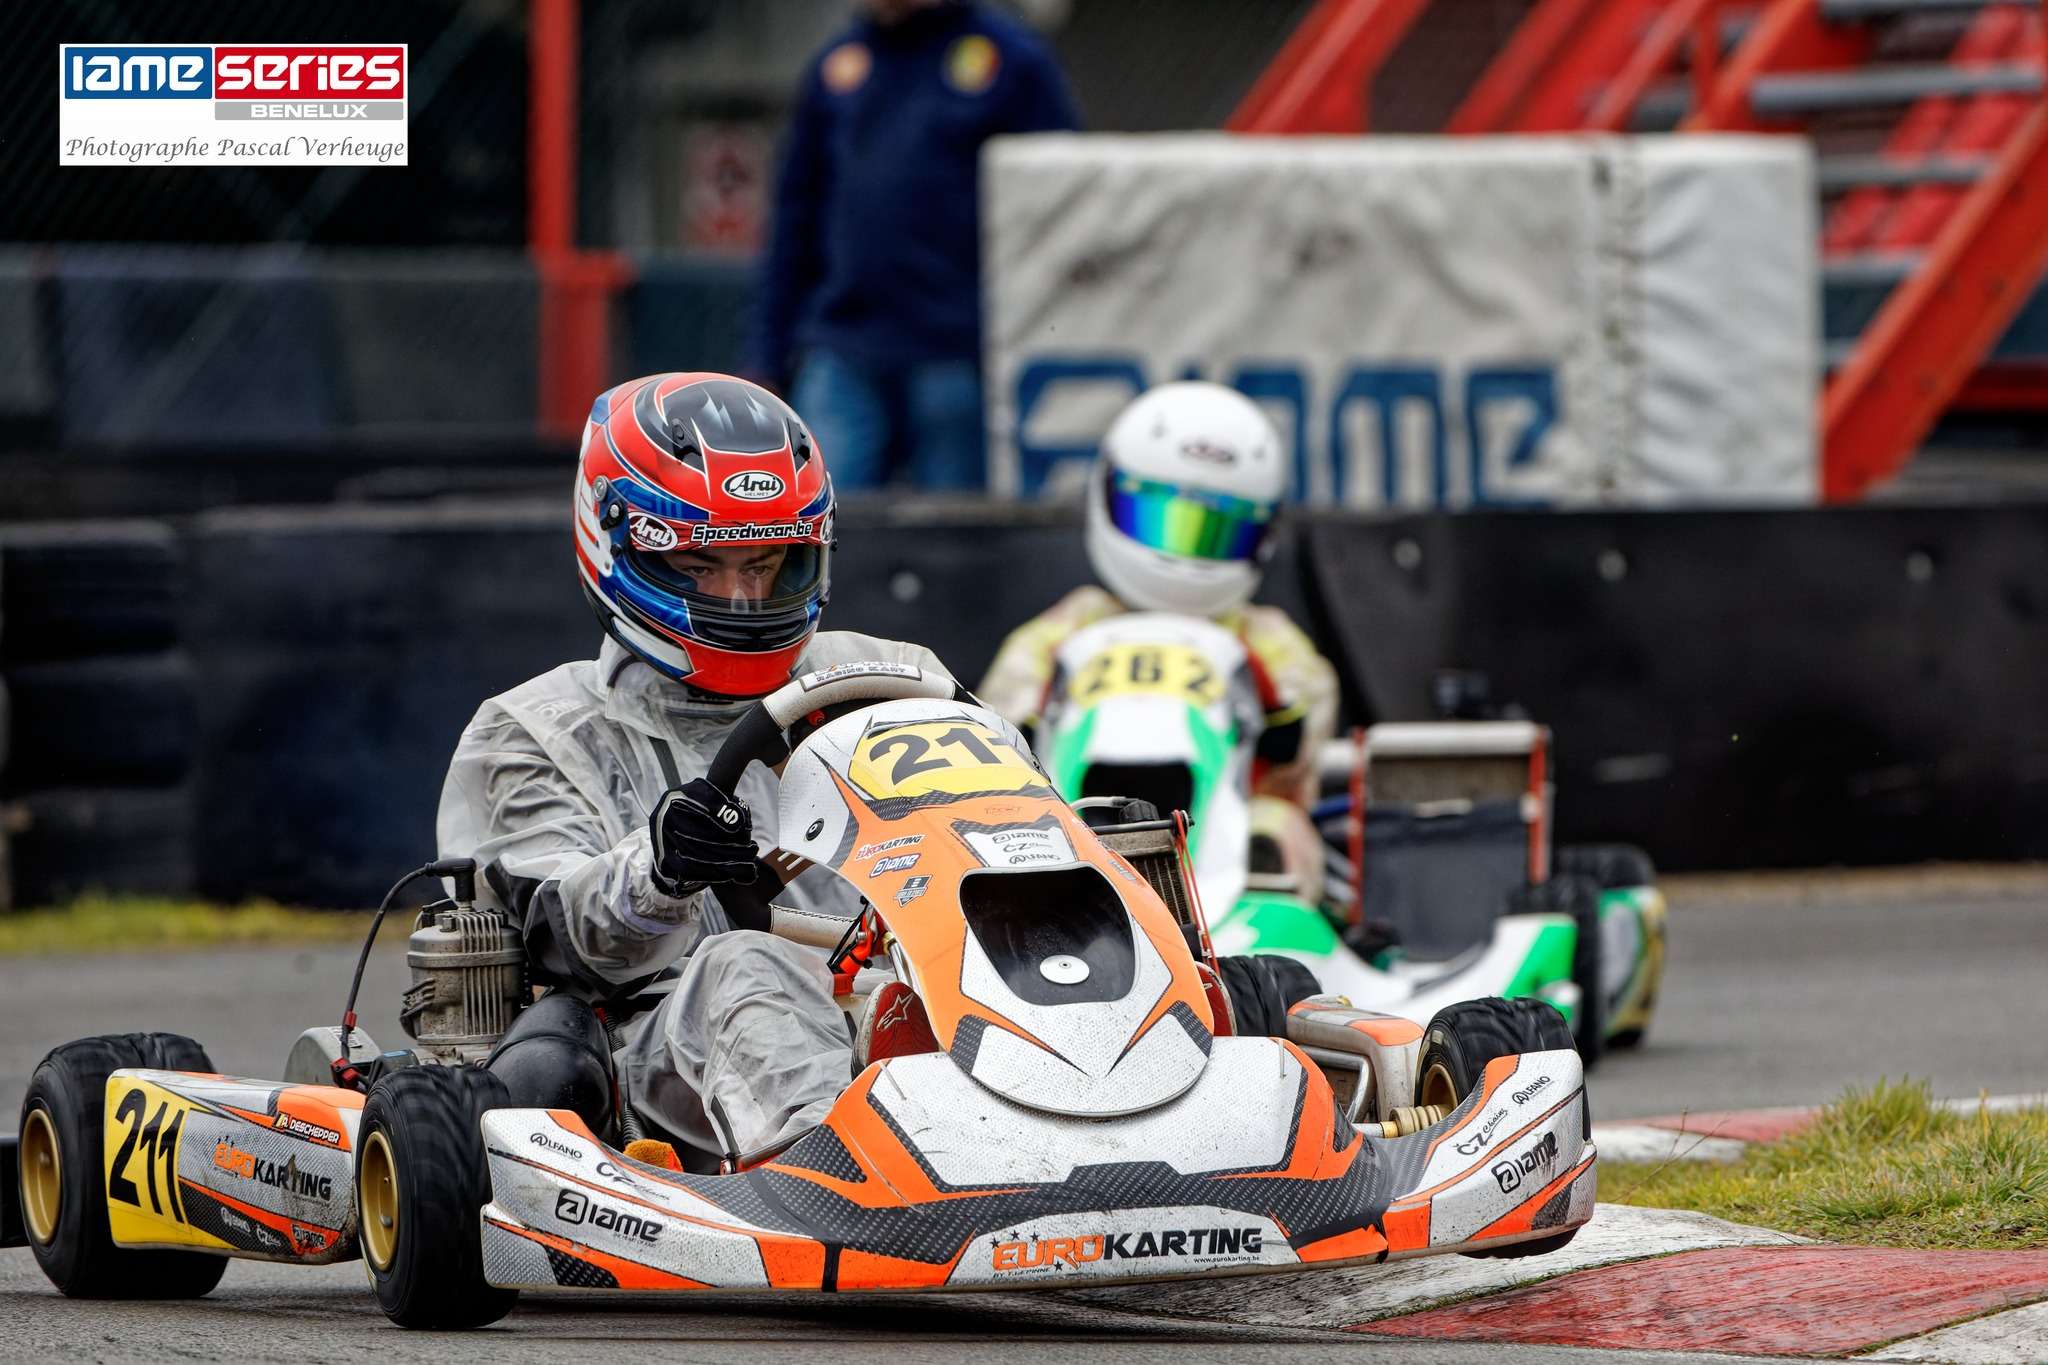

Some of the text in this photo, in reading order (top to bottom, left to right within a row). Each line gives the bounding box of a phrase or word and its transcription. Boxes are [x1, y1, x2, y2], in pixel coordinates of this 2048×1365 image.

[730, 474, 778, 493] Arai
[630, 516, 671, 544] Arai
[692, 521, 812, 545] Speedwear.be
[1083, 654, 1216, 693] 262
[289, 1119, 340, 1143] DESCHEPPER
[109, 1088, 185, 1224] 211
[530, 1132, 583, 1160] ALFANO
[992, 1228, 1263, 1271] EUROKARTING
